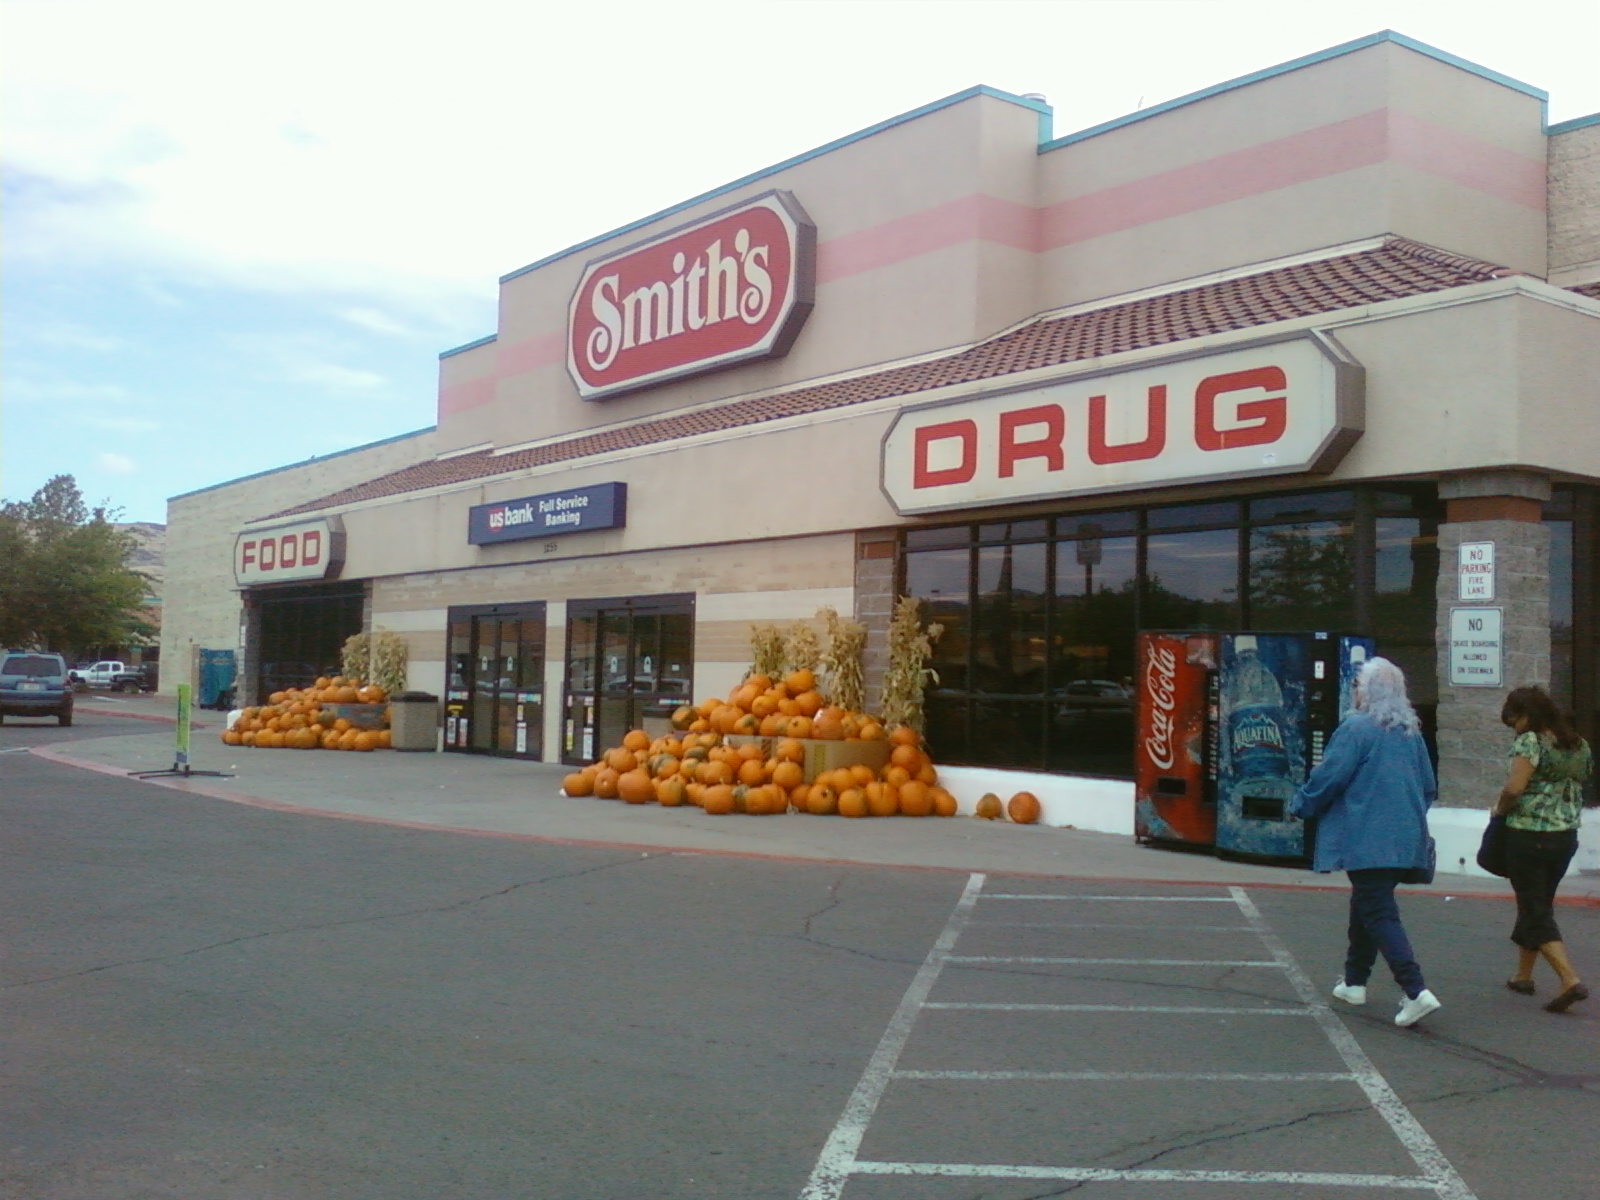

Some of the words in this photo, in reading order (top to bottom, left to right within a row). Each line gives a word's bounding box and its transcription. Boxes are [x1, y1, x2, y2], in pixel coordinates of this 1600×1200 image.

[586, 228, 772, 371] Smith's
[913, 365, 1287, 490] DRUG
[539, 500, 554, 513] Full
[556, 495, 588, 510] Service
[545, 511, 580, 527] Banking
[242, 530, 320, 574] FOOD
[1470, 549, 1483, 560] NO
[1461, 564, 1492, 574] PARKING
[1468, 576, 1484, 585] FIRE
[1467, 586, 1485, 595] LANE
[1468, 618, 1483, 631] NO
[1145, 641, 1176, 770] Coca-Cola
[1233, 724, 1282, 752] AQUAFINA
